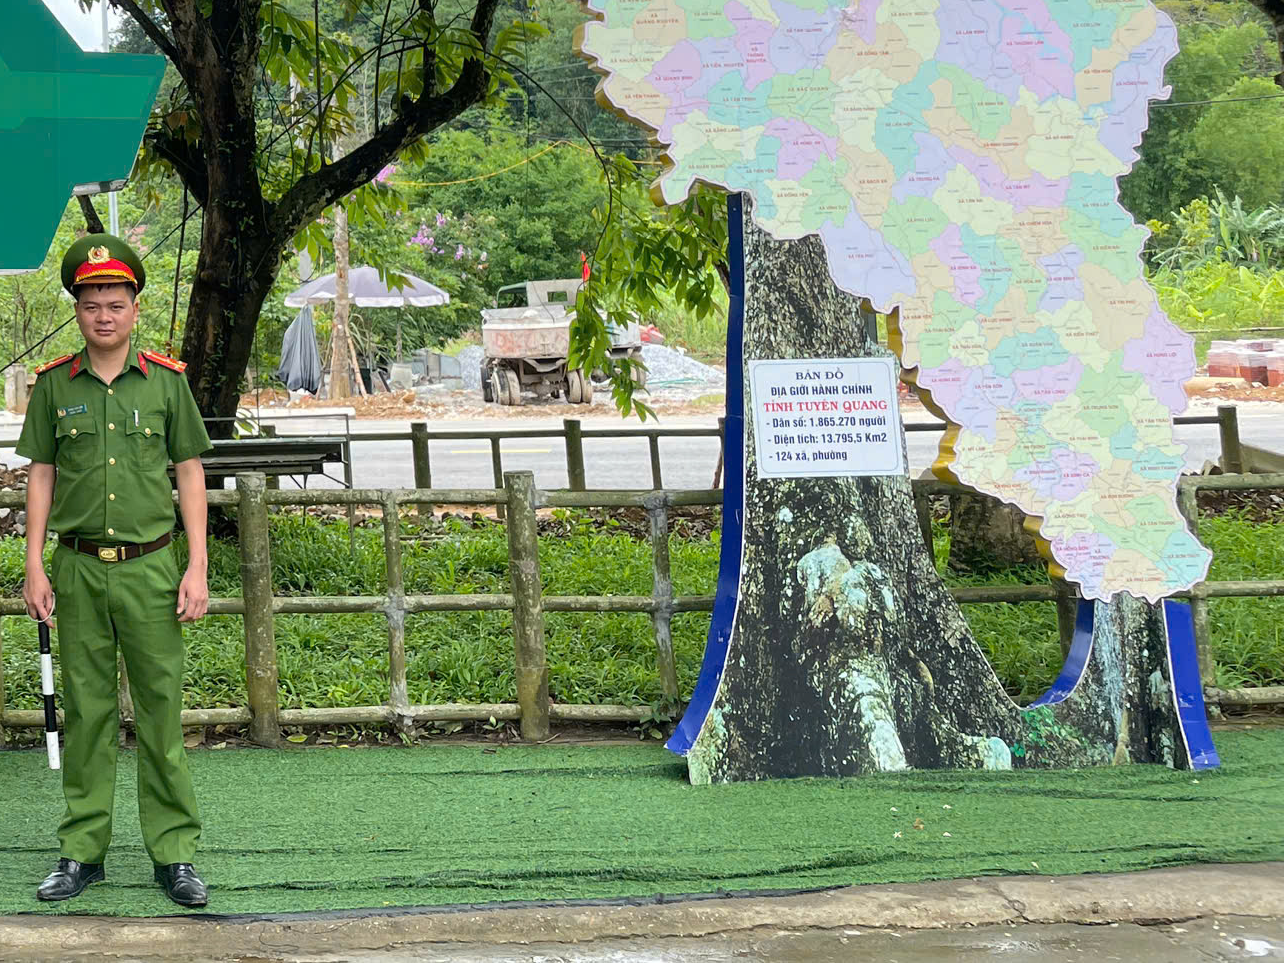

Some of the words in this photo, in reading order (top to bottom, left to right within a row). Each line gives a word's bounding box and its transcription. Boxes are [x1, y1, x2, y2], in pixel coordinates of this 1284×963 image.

[796, 369, 821, 380] BẢN
[825, 367, 844, 380] ĐỒ
[771, 386, 787, 398] ĐỊA
[790, 385, 809, 395] GIỚI
[812, 384, 839, 395] HÀNH
[842, 383, 872, 394] CHÍNH
[764, 400, 793, 412] TỈNH
[797, 399, 838, 411] TUYÊN
[842, 400, 887, 414] QUANG
[772, 418, 790, 428] Dân
[809, 417, 856, 427] 1.865.270
[859, 415, 886, 427] người
[774, 434, 795, 446] Diện
[821, 433, 862, 444] 13.795,5
[865, 432, 887, 442] Km2
[776, 451, 792, 461] 124
[812, 450, 847, 461] phường
